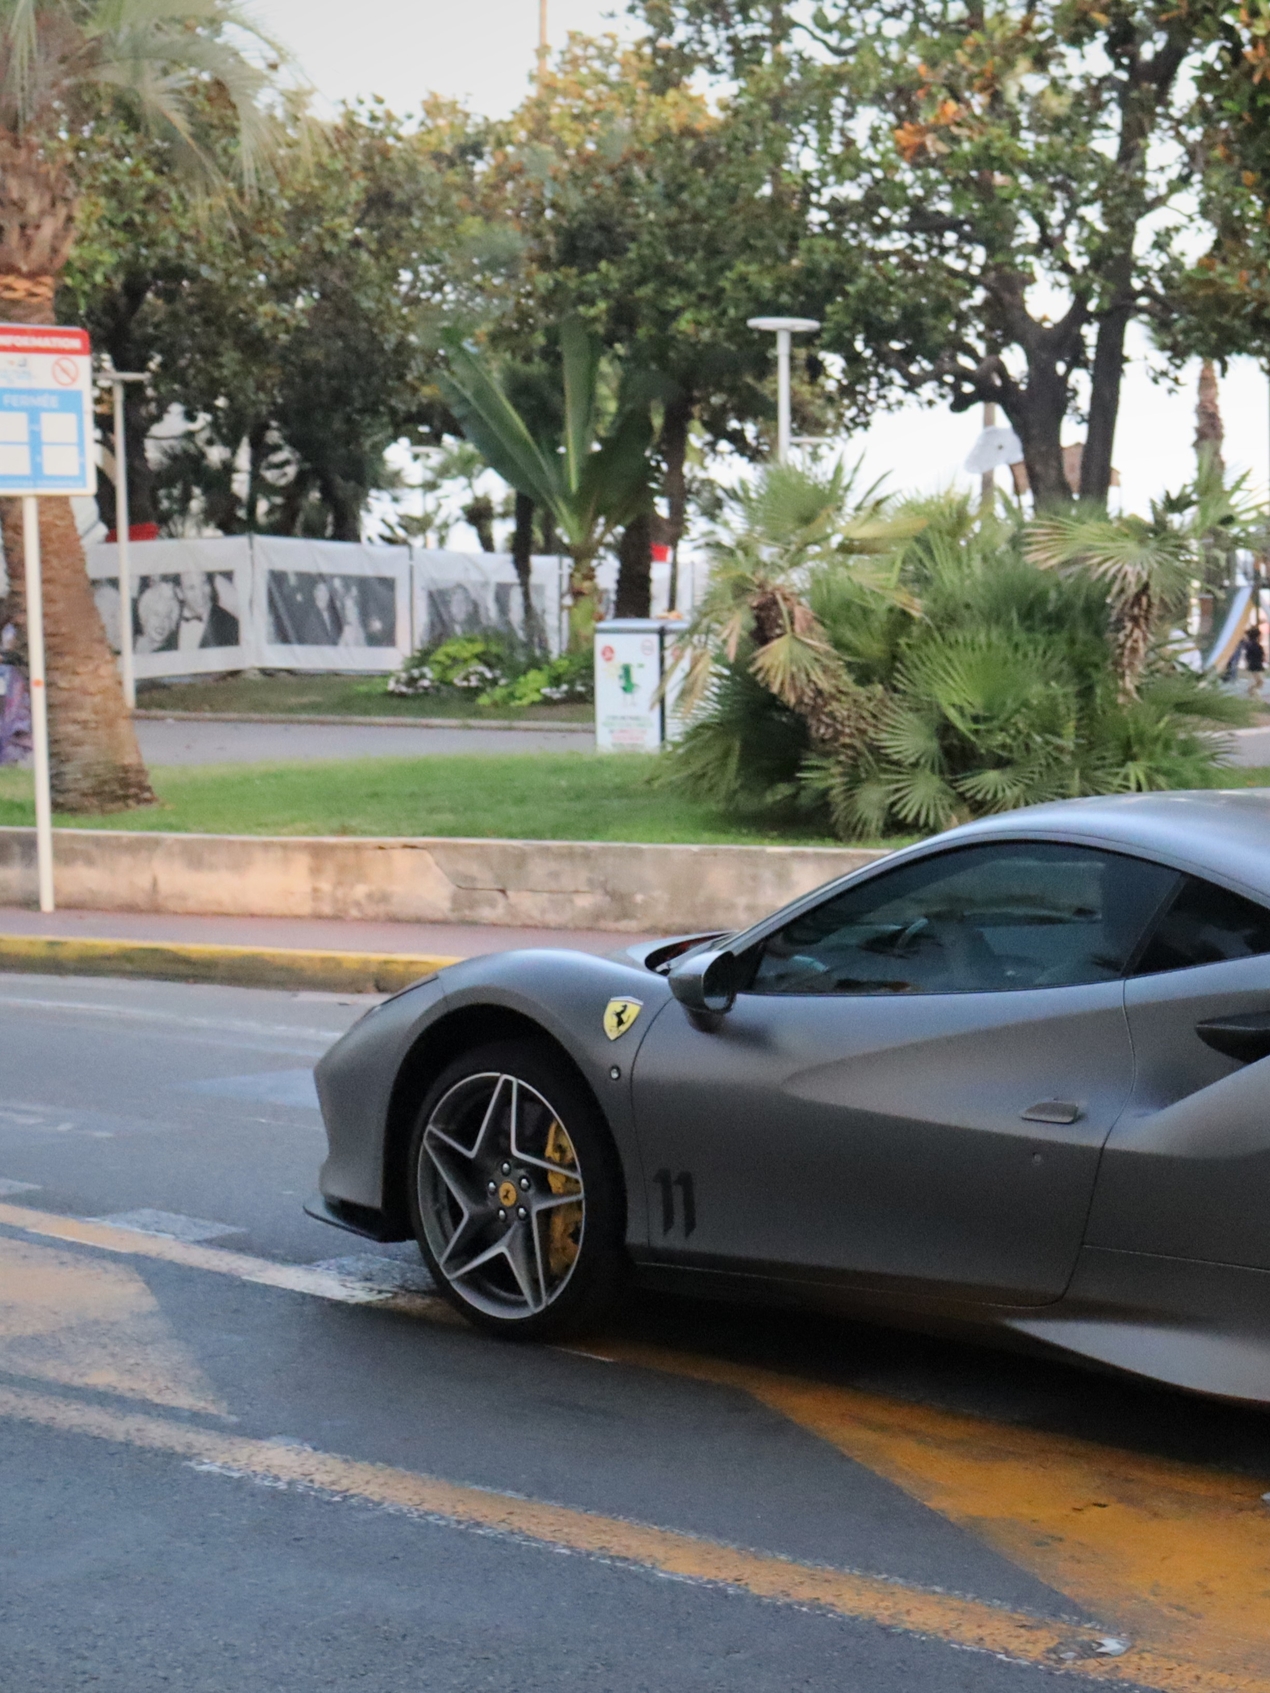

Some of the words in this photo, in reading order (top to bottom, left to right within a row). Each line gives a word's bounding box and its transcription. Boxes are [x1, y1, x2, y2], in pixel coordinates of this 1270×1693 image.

[0, 335, 82, 349] NFORMATION
[3, 392, 59, 409] FERMÉE
[652, 1168, 697, 1239] 11
